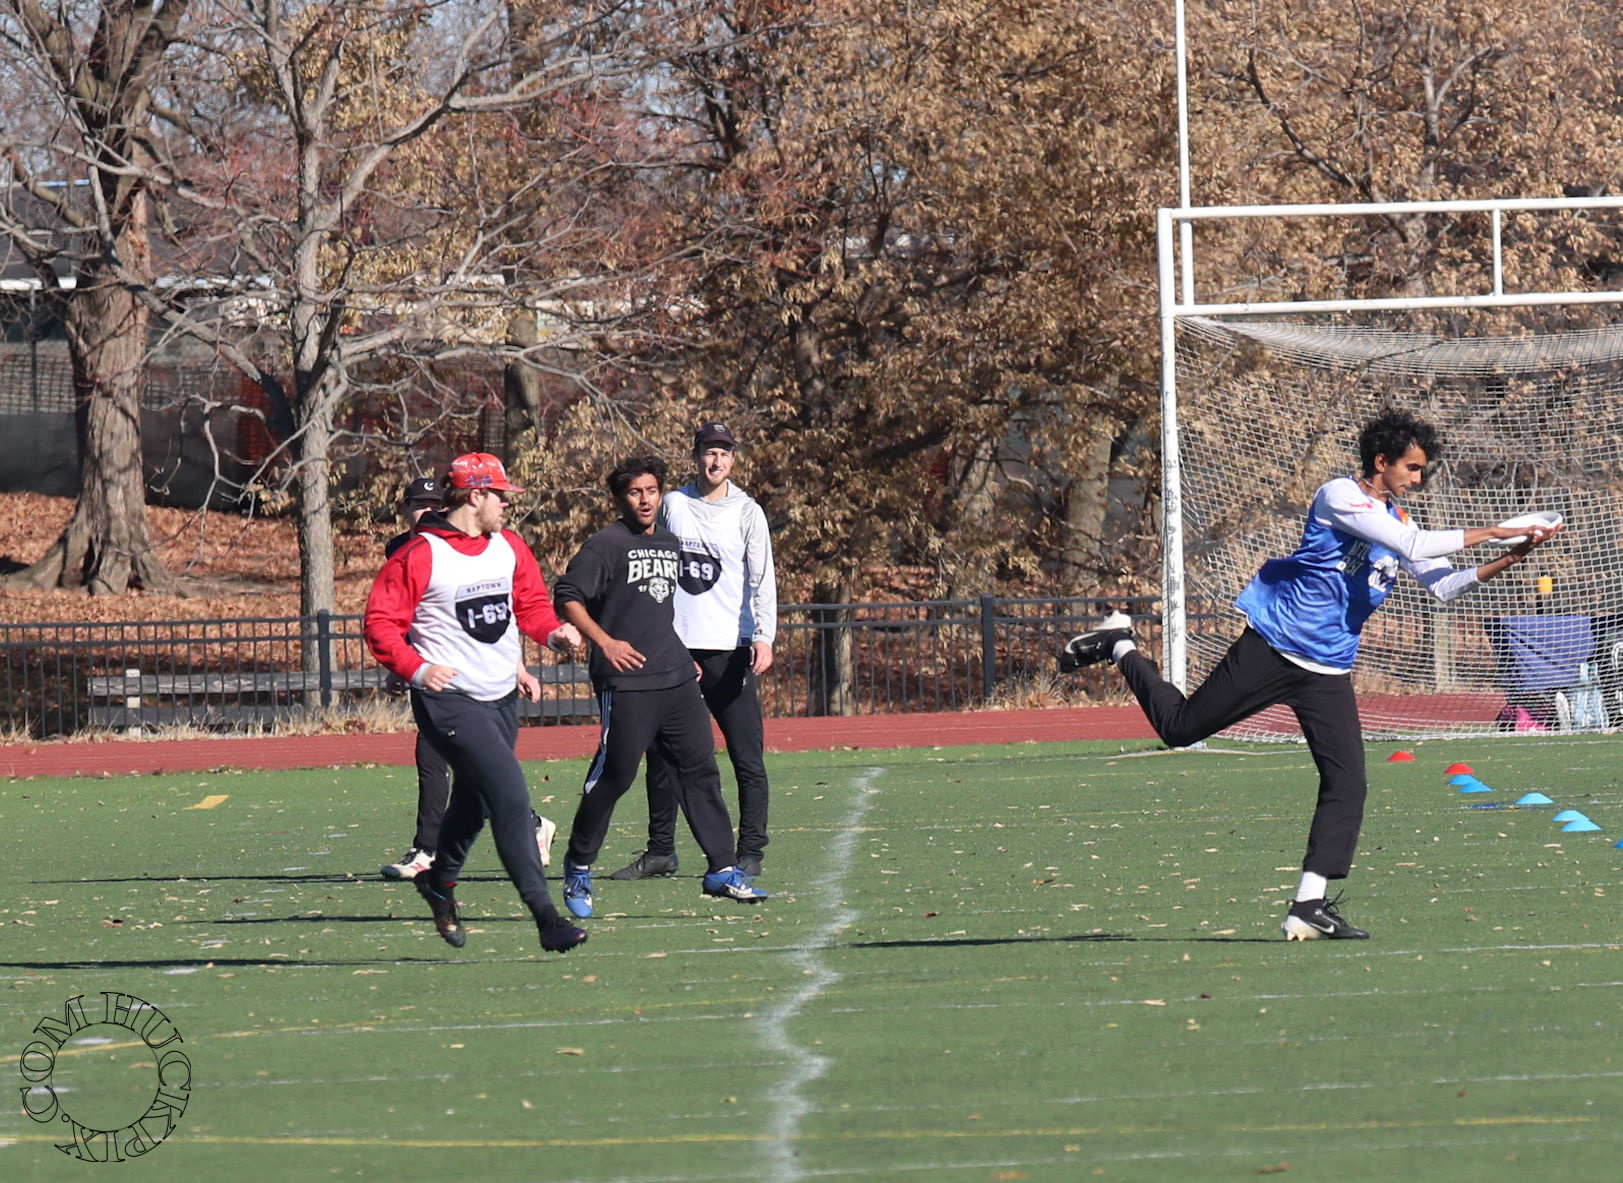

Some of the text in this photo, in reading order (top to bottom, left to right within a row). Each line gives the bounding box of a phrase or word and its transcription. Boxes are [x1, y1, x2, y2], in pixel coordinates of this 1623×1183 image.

[627, 548, 679, 561] CHICAGO
[679, 560, 714, 581] I-69
[466, 582, 502, 594] NAPTOWN
